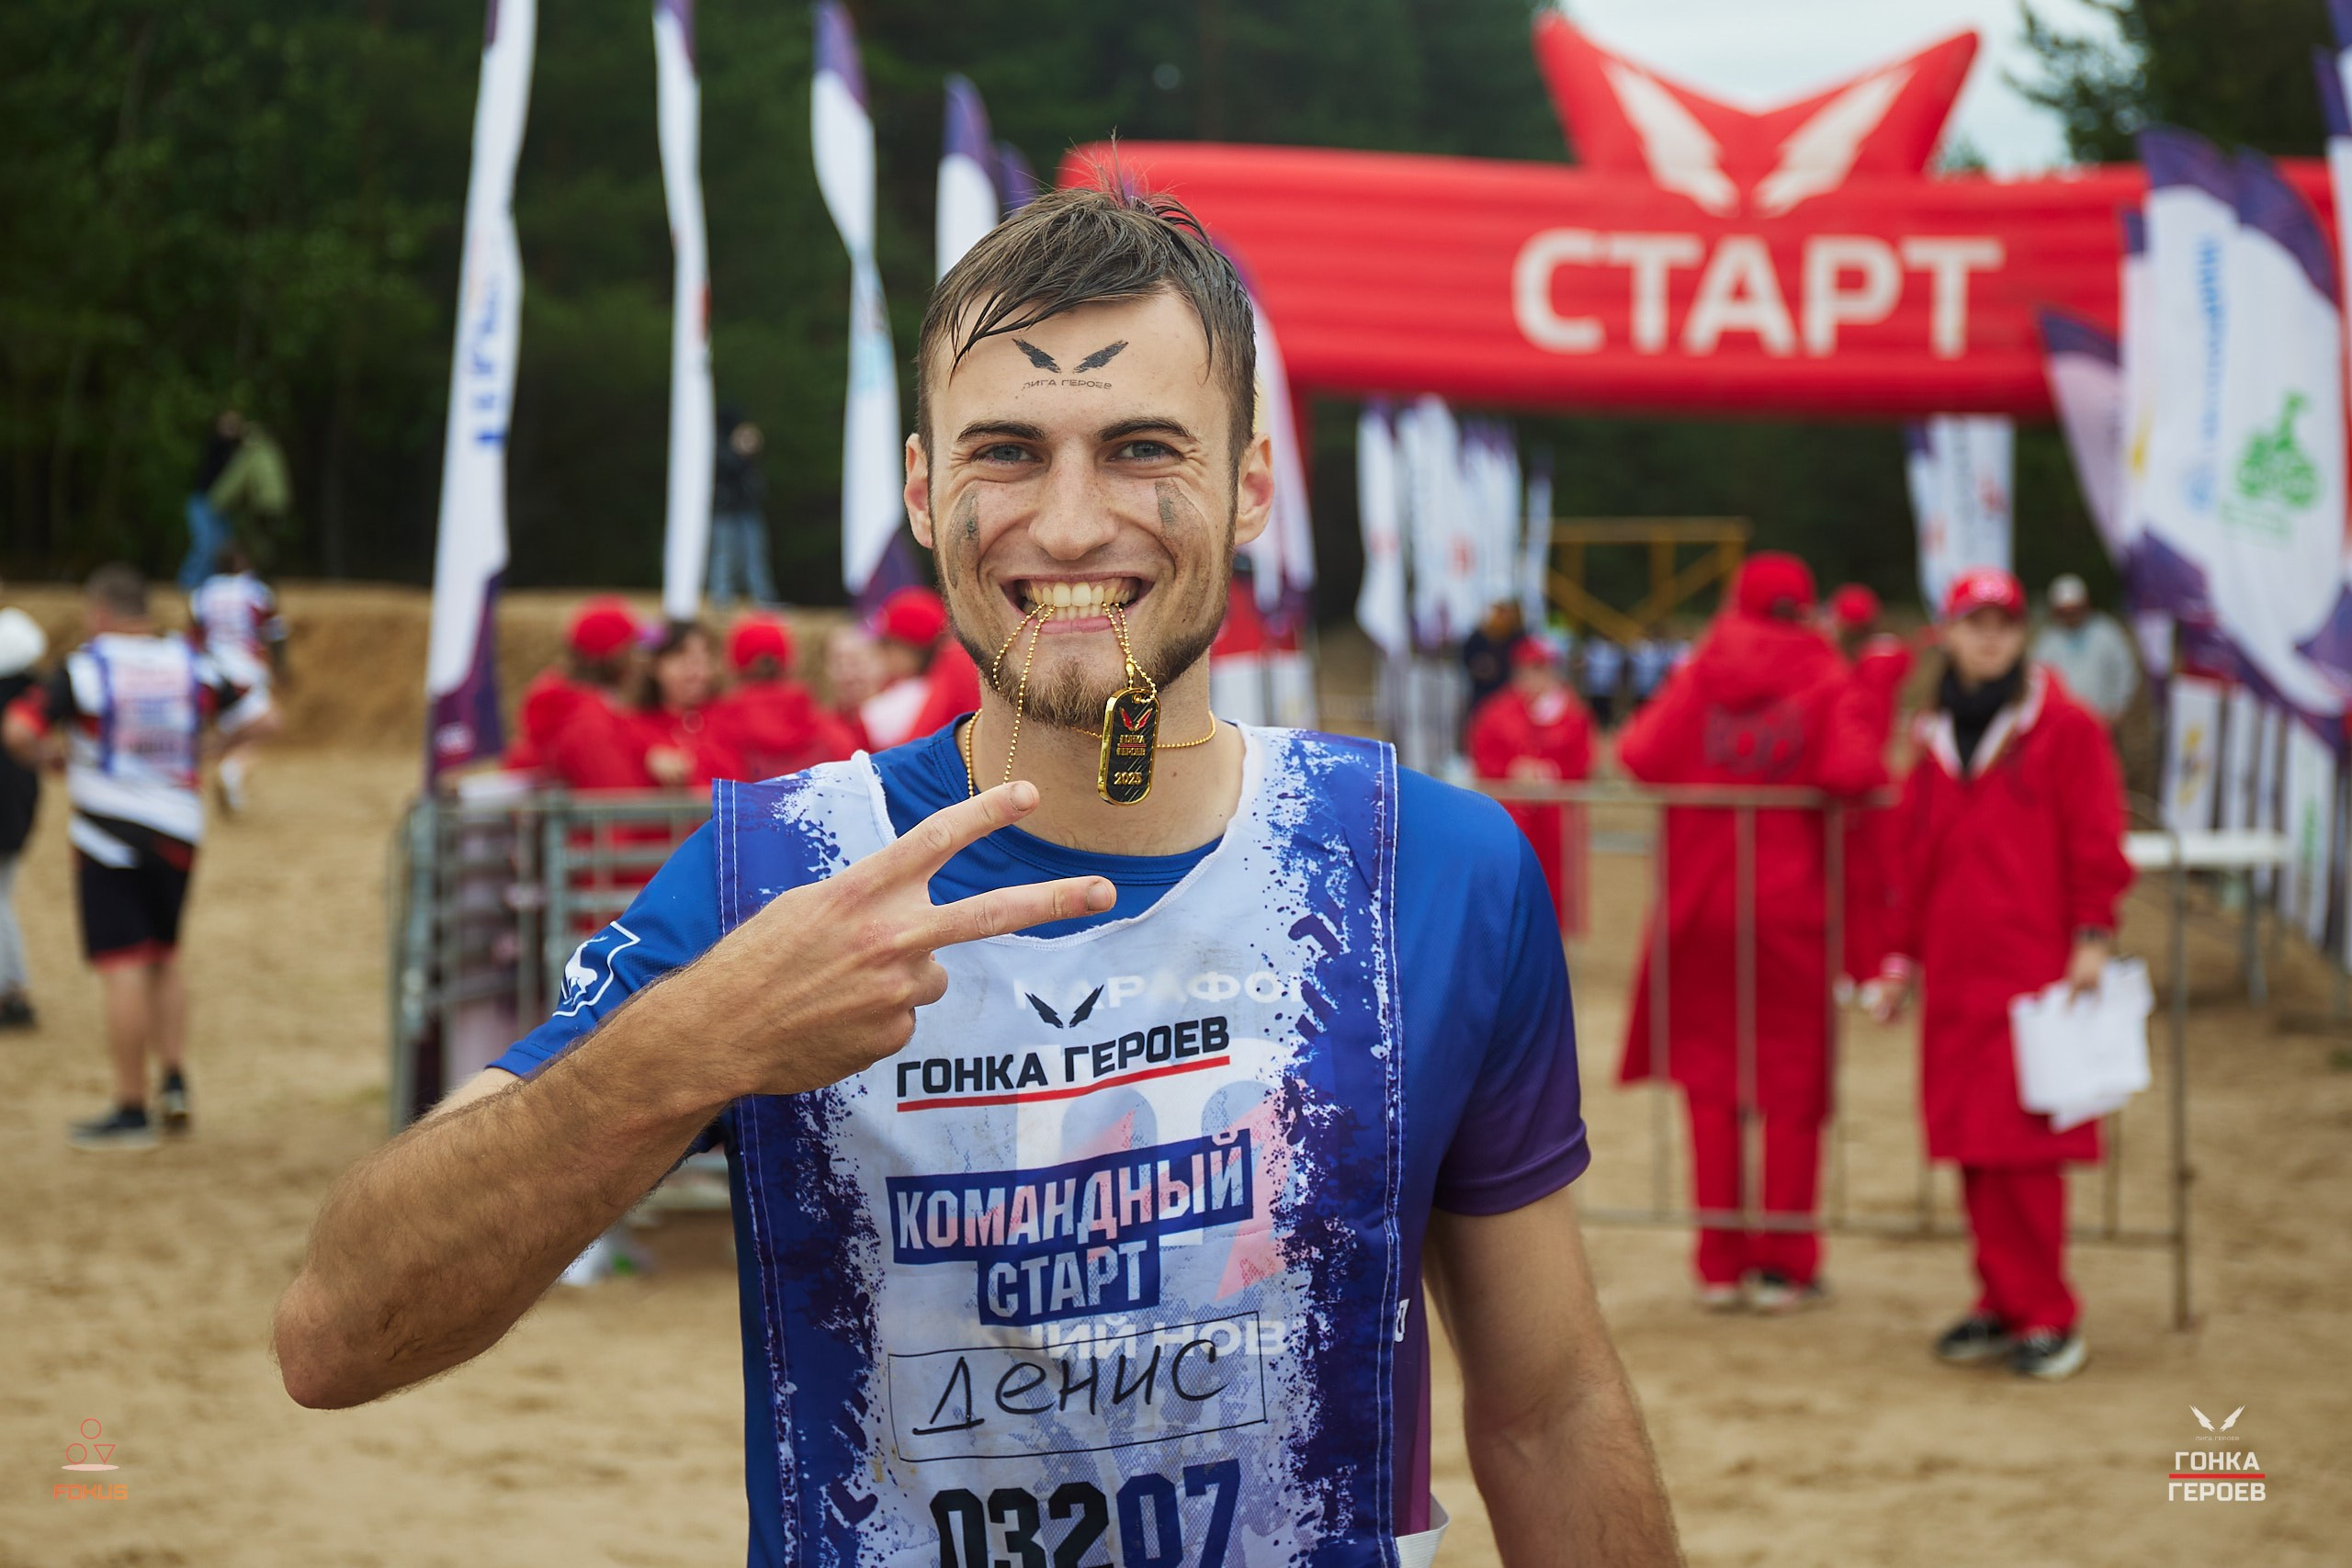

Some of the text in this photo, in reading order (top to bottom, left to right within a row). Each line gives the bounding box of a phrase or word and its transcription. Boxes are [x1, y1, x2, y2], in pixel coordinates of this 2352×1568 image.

[1511, 227, 2006, 360] СТАРТ
[897, 1016, 1230, 1098] ГОНКА ГЕРОЕВ
[897, 1131, 1244, 1250] КОМАНДНЫЙ
[988, 1240, 1148, 1318] СТАРТ
[929, 1459, 1241, 1568] 03207
